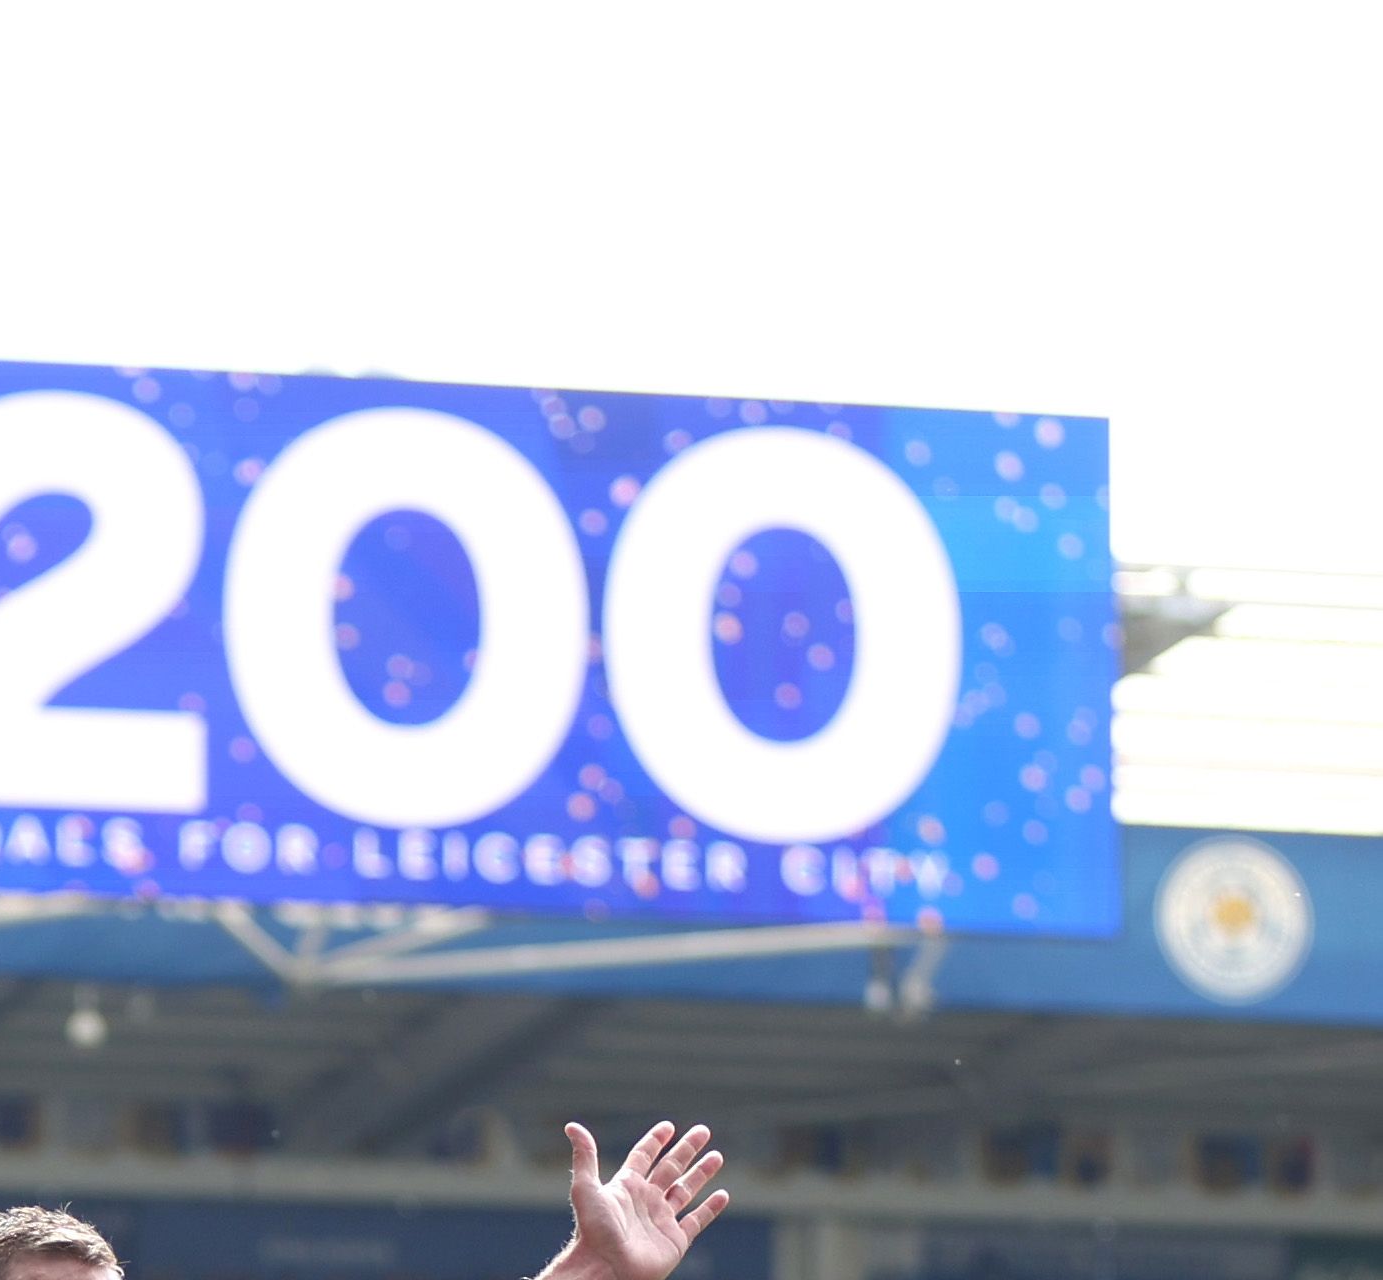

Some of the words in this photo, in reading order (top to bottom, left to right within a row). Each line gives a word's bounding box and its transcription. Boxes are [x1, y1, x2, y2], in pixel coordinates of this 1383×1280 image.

[177, 818, 317, 875] FOR
[352, 826, 748, 893] LEICESTER
[780, 843, 949, 898] CITY
